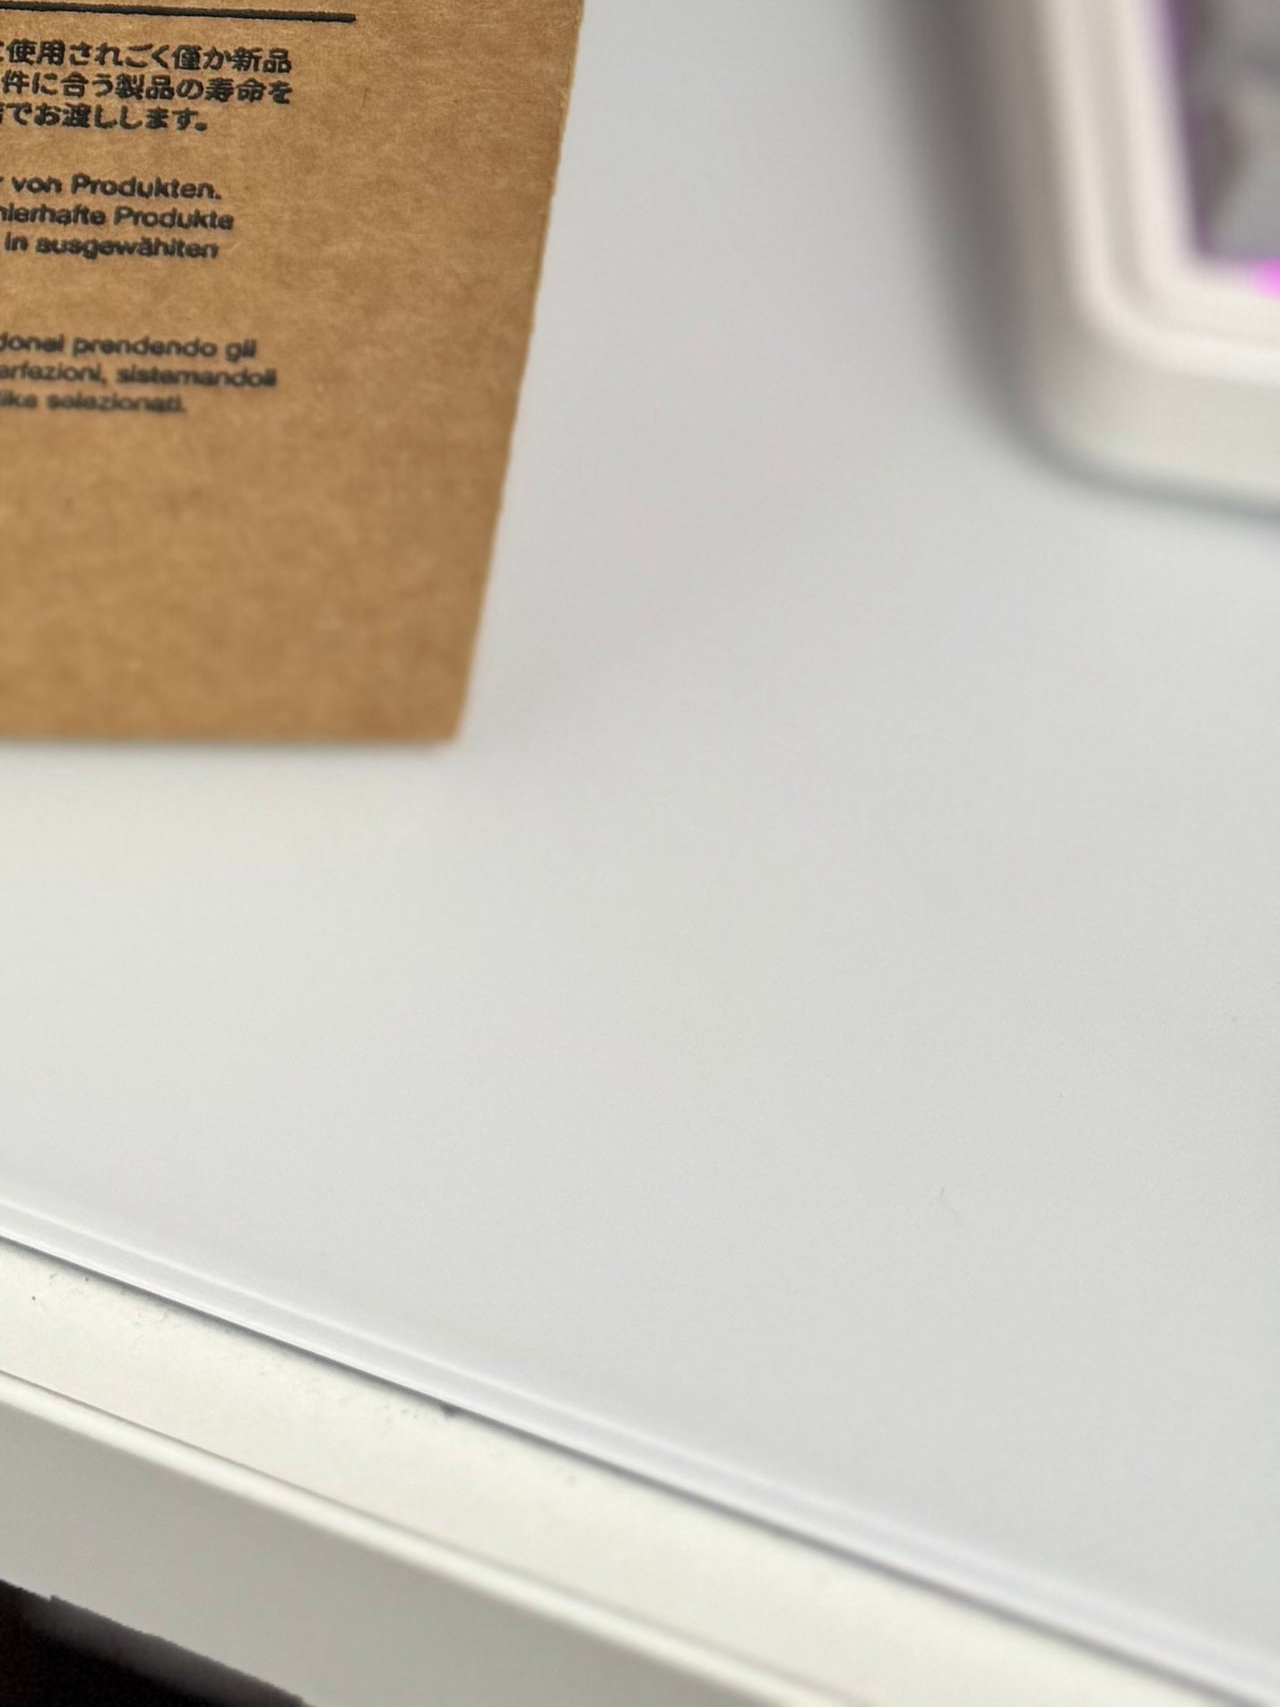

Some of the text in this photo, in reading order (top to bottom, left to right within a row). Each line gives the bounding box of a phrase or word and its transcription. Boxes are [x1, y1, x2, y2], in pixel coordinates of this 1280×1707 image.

[11, 176, 64, 195] von
[70, 172, 223, 201] Produkten.
[113, 205, 235, 232] Produkte
[4, 231, 30, 253] in
[71, 335, 219, 359] prendendo
[224, 338, 258, 365] gli
